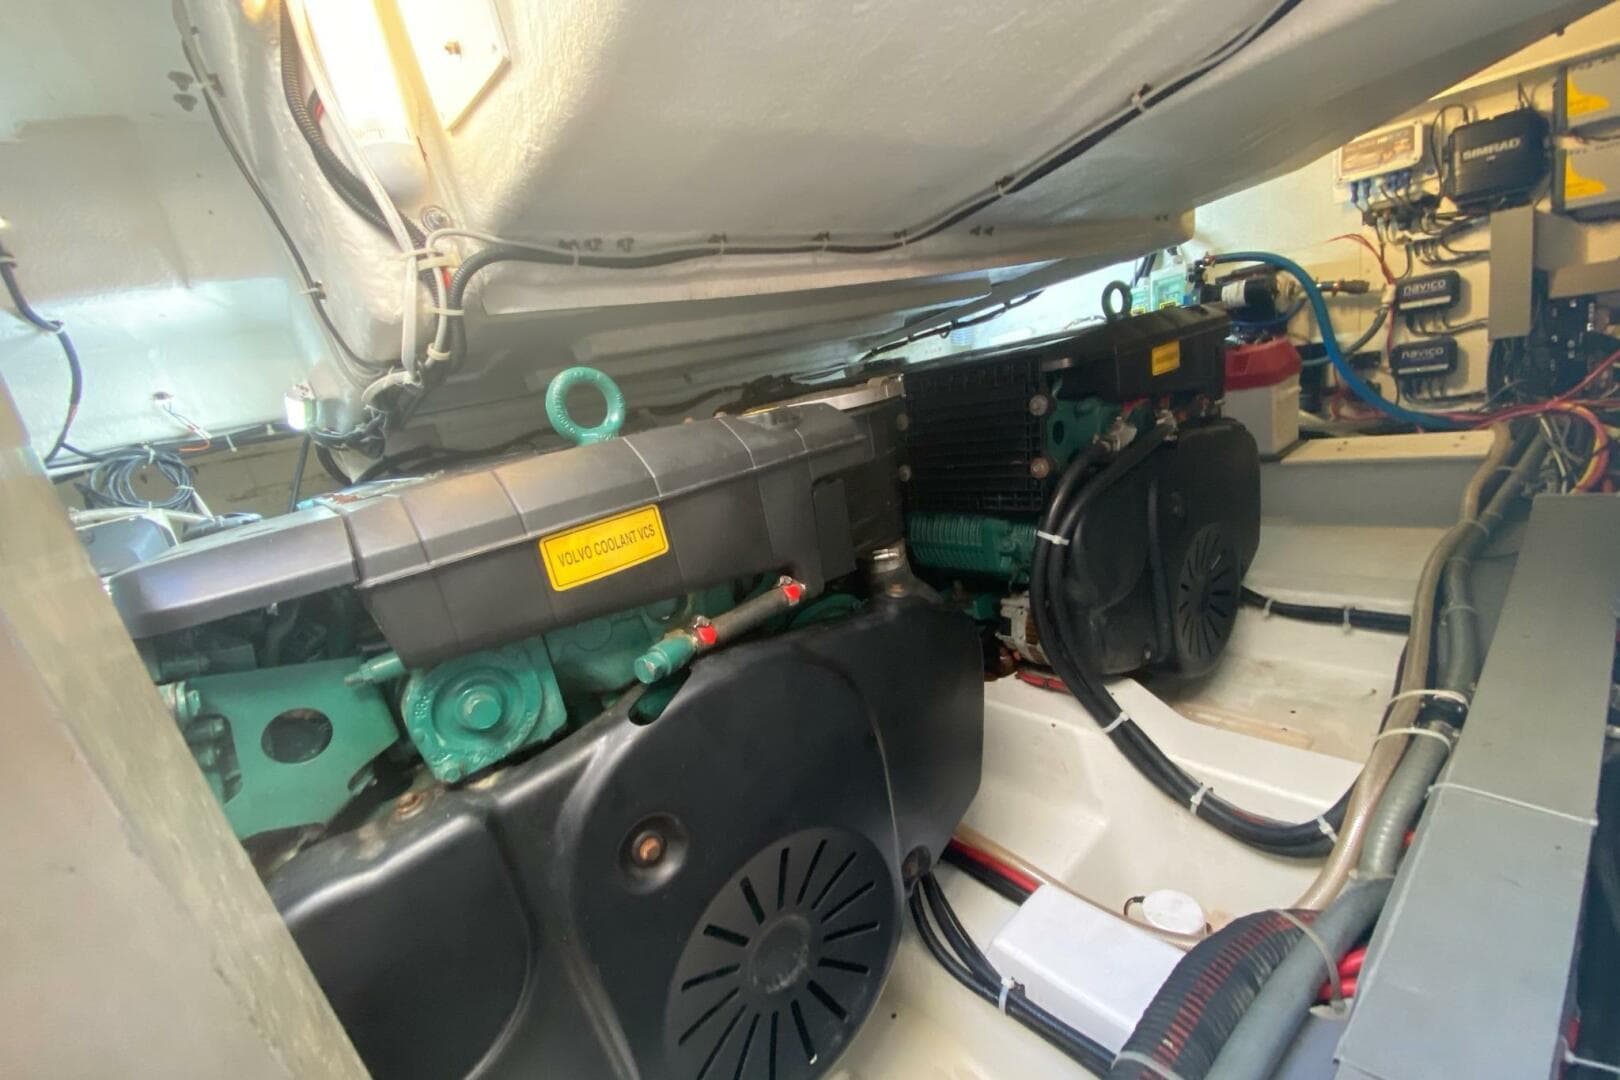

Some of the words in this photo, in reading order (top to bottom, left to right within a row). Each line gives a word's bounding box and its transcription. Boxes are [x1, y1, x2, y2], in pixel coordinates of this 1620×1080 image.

[1462, 137, 1521, 161] SIMRAD
[1403, 279, 1446, 297] navico
[1401, 346, 1444, 360] navico
[558, 545, 592, 567] VOLVO
[594, 530, 637, 556] COOLANT
[639, 524, 656, 540] VCS
